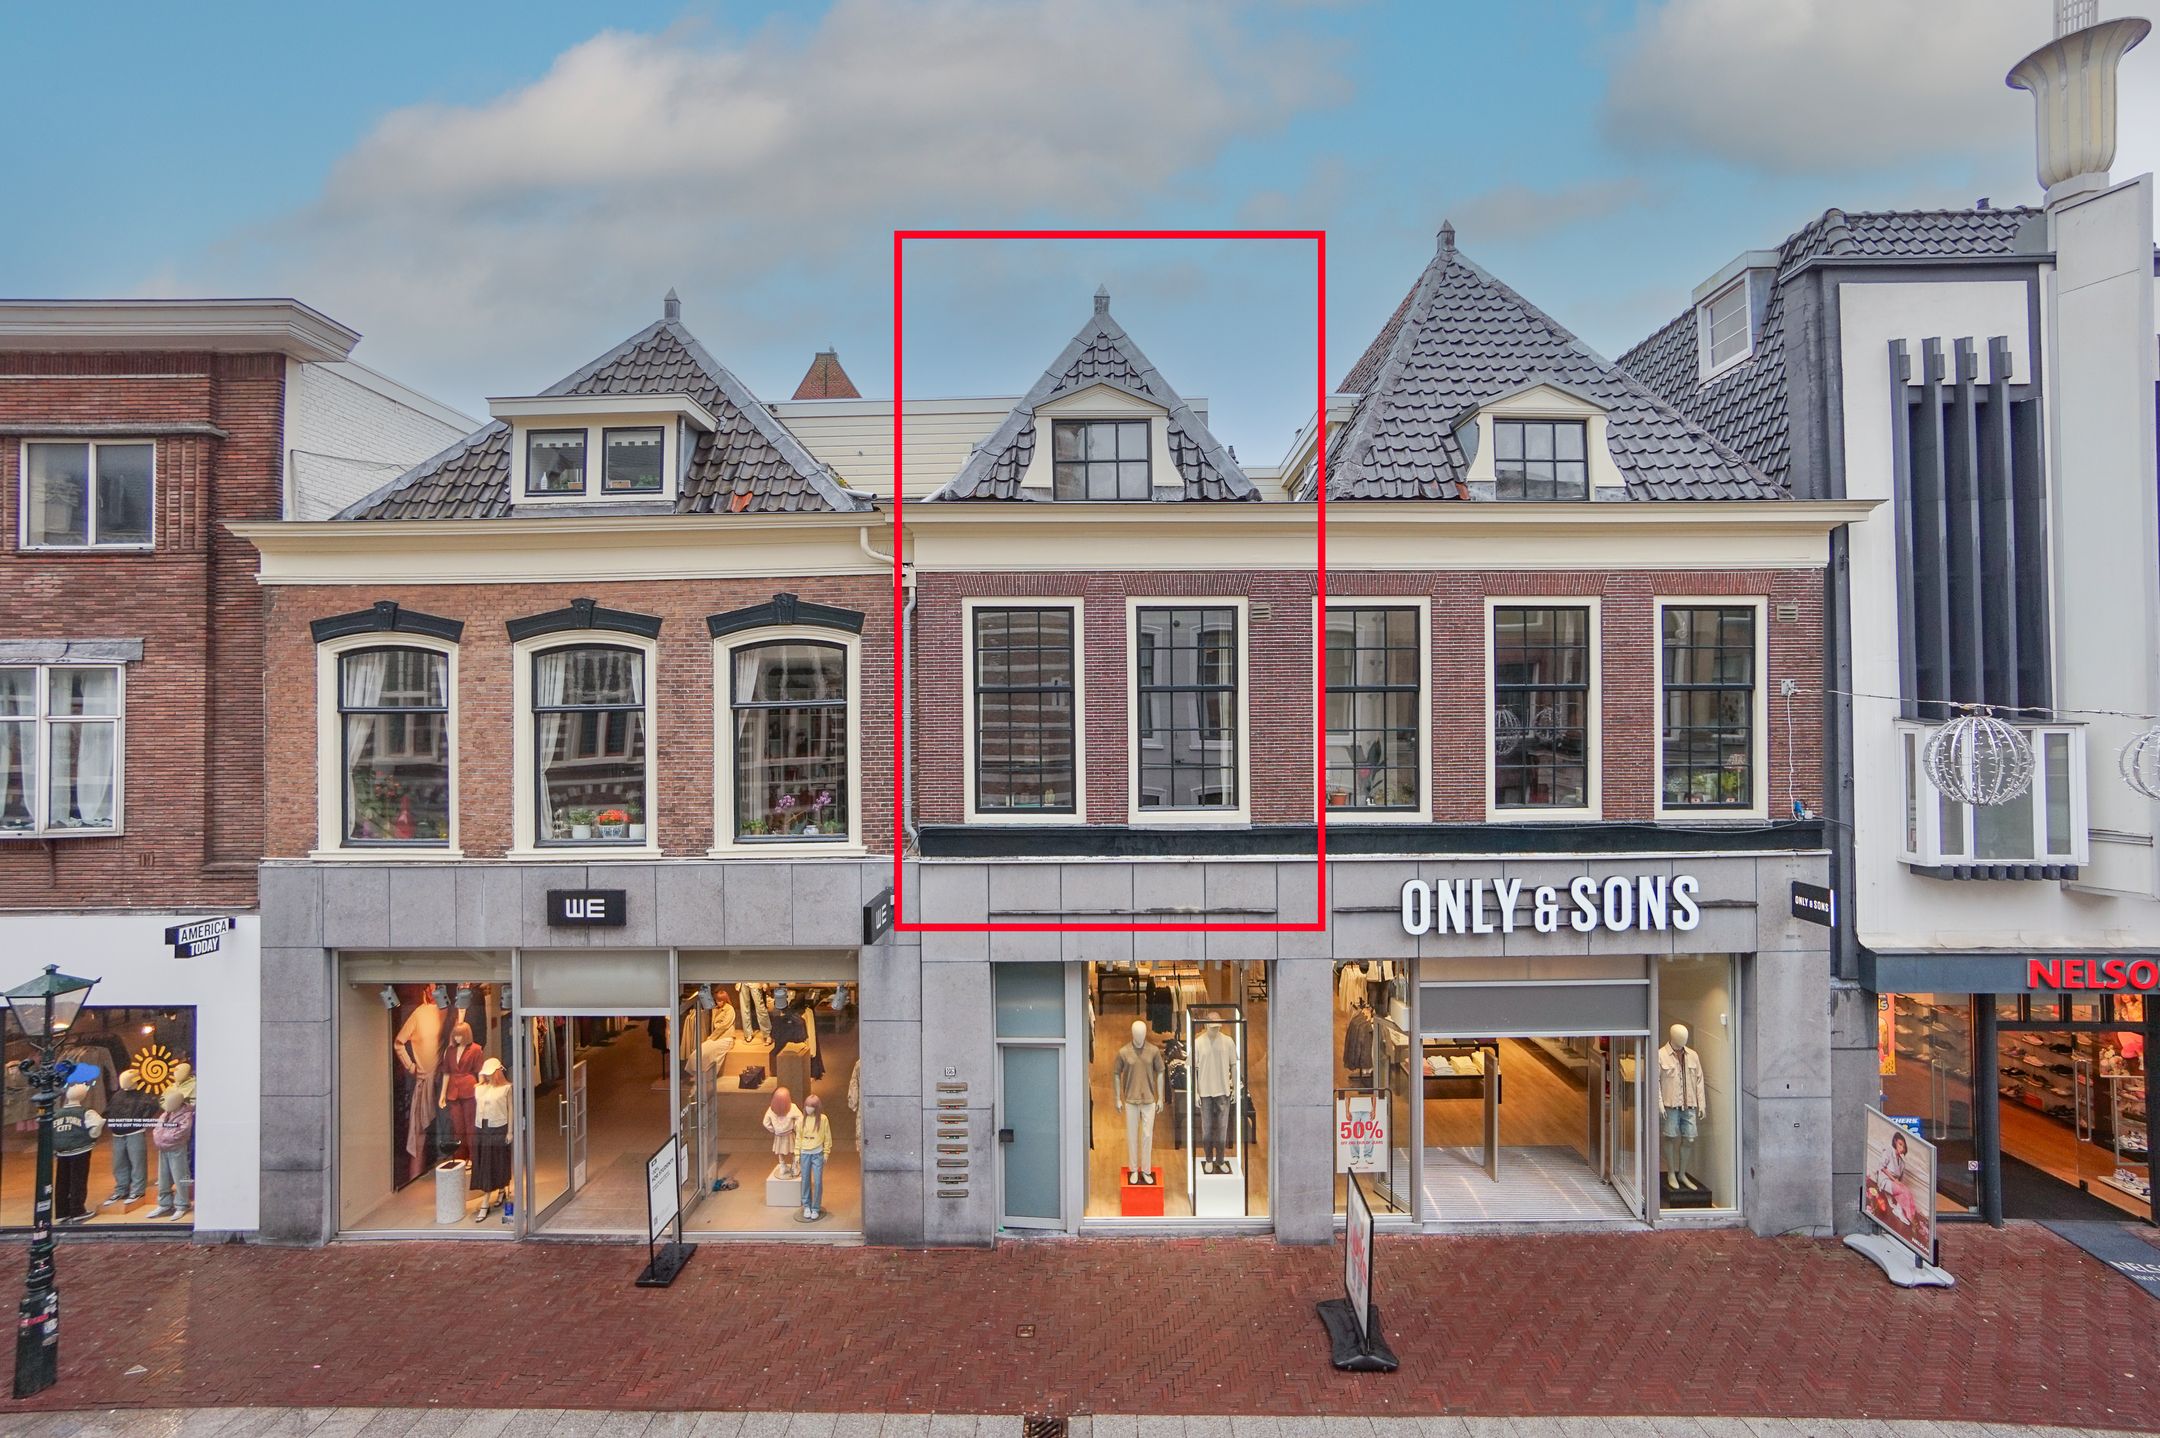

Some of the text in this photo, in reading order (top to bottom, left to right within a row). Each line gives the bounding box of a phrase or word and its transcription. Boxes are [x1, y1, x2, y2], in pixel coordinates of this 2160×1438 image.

[565, 898, 605, 918] WE
[1402, 876, 1700, 935] ONLY & SONS
[1794, 895, 1809, 907] ONLY
[1813, 900, 1829, 912] SONS
[875, 903, 887, 930] WE
[181, 920, 227, 942] AMERICA
[190, 937, 219, 956] TODAY
[2027, 959, 2160, 990] NELSO
[53, 1117, 65, 1128] EW
[1340, 1120, 1384, 1139] 50%
[2109, 1260, 2160, 1274] NELS
